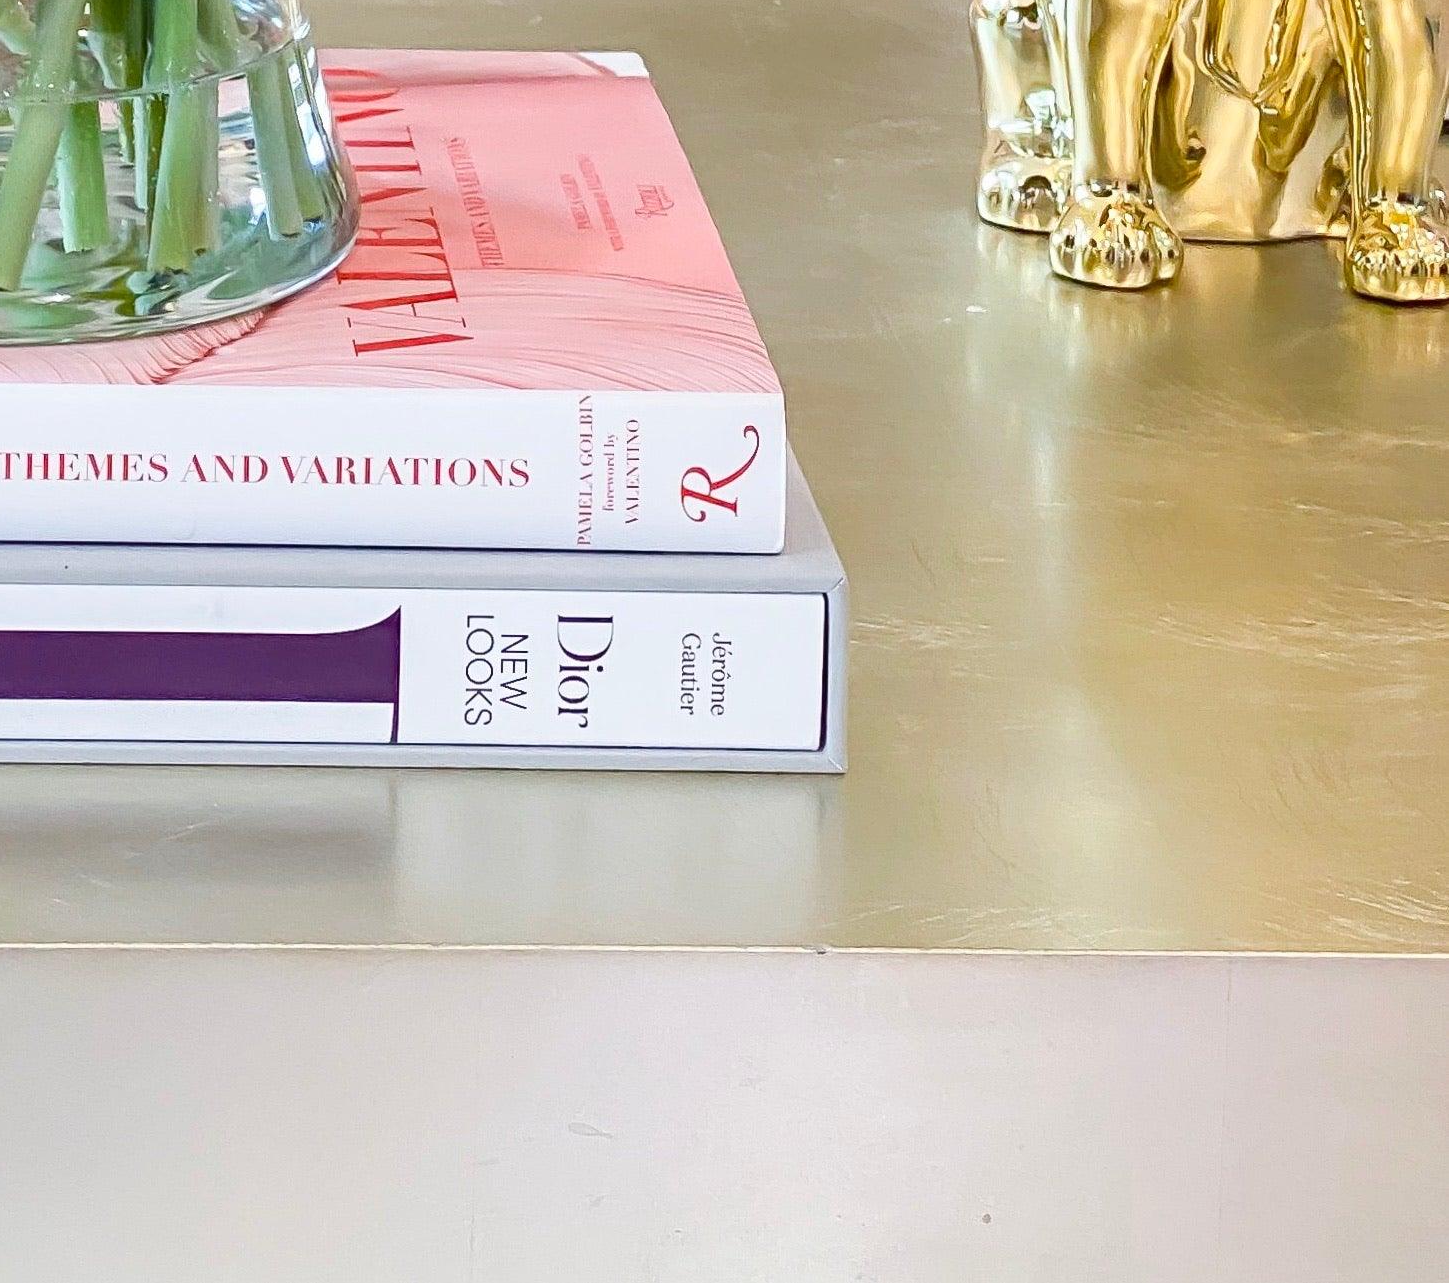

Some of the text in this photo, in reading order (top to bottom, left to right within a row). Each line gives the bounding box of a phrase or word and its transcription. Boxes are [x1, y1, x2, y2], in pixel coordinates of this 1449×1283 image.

[181, 453, 269, 484] AND
[280, 455, 531, 488] VARIATIONS
[577, 395, 593, 546] PAMELA GOLBIN
[602, 433, 618, 512] foreword by
[625, 419, 640, 524] VALENTINO
[681, 425, 760, 522] R
[464, 614, 495, 726] LOOKS
[499, 633, 530, 710] NEW
[557, 615, 614, 729] Dior
[679, 632, 702, 716] Gautier
[710, 631, 732, 717] Jérôme
